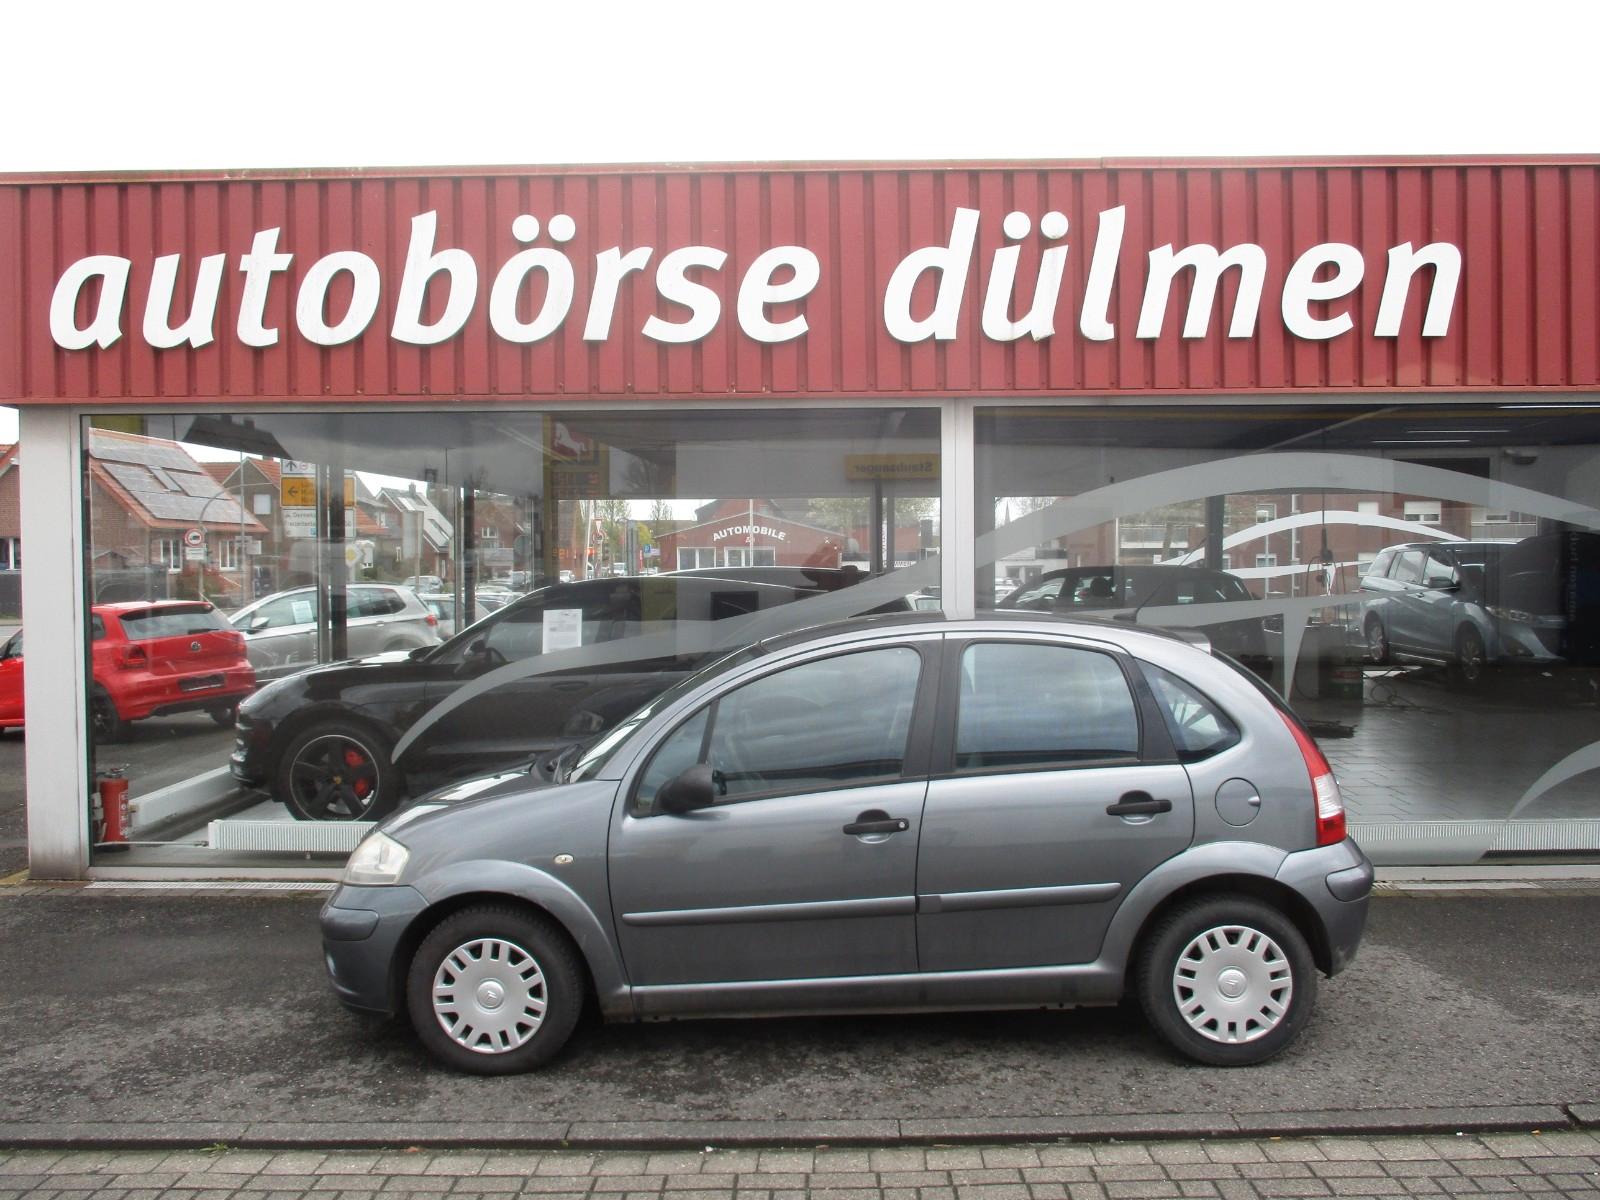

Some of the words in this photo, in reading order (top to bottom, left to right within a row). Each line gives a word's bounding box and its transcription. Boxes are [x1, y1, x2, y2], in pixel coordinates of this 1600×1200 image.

[50, 209, 820, 349] autobörse
[884, 204, 1461, 341] dülmen
[713, 525, 786, 542] AUTOMOBILE
